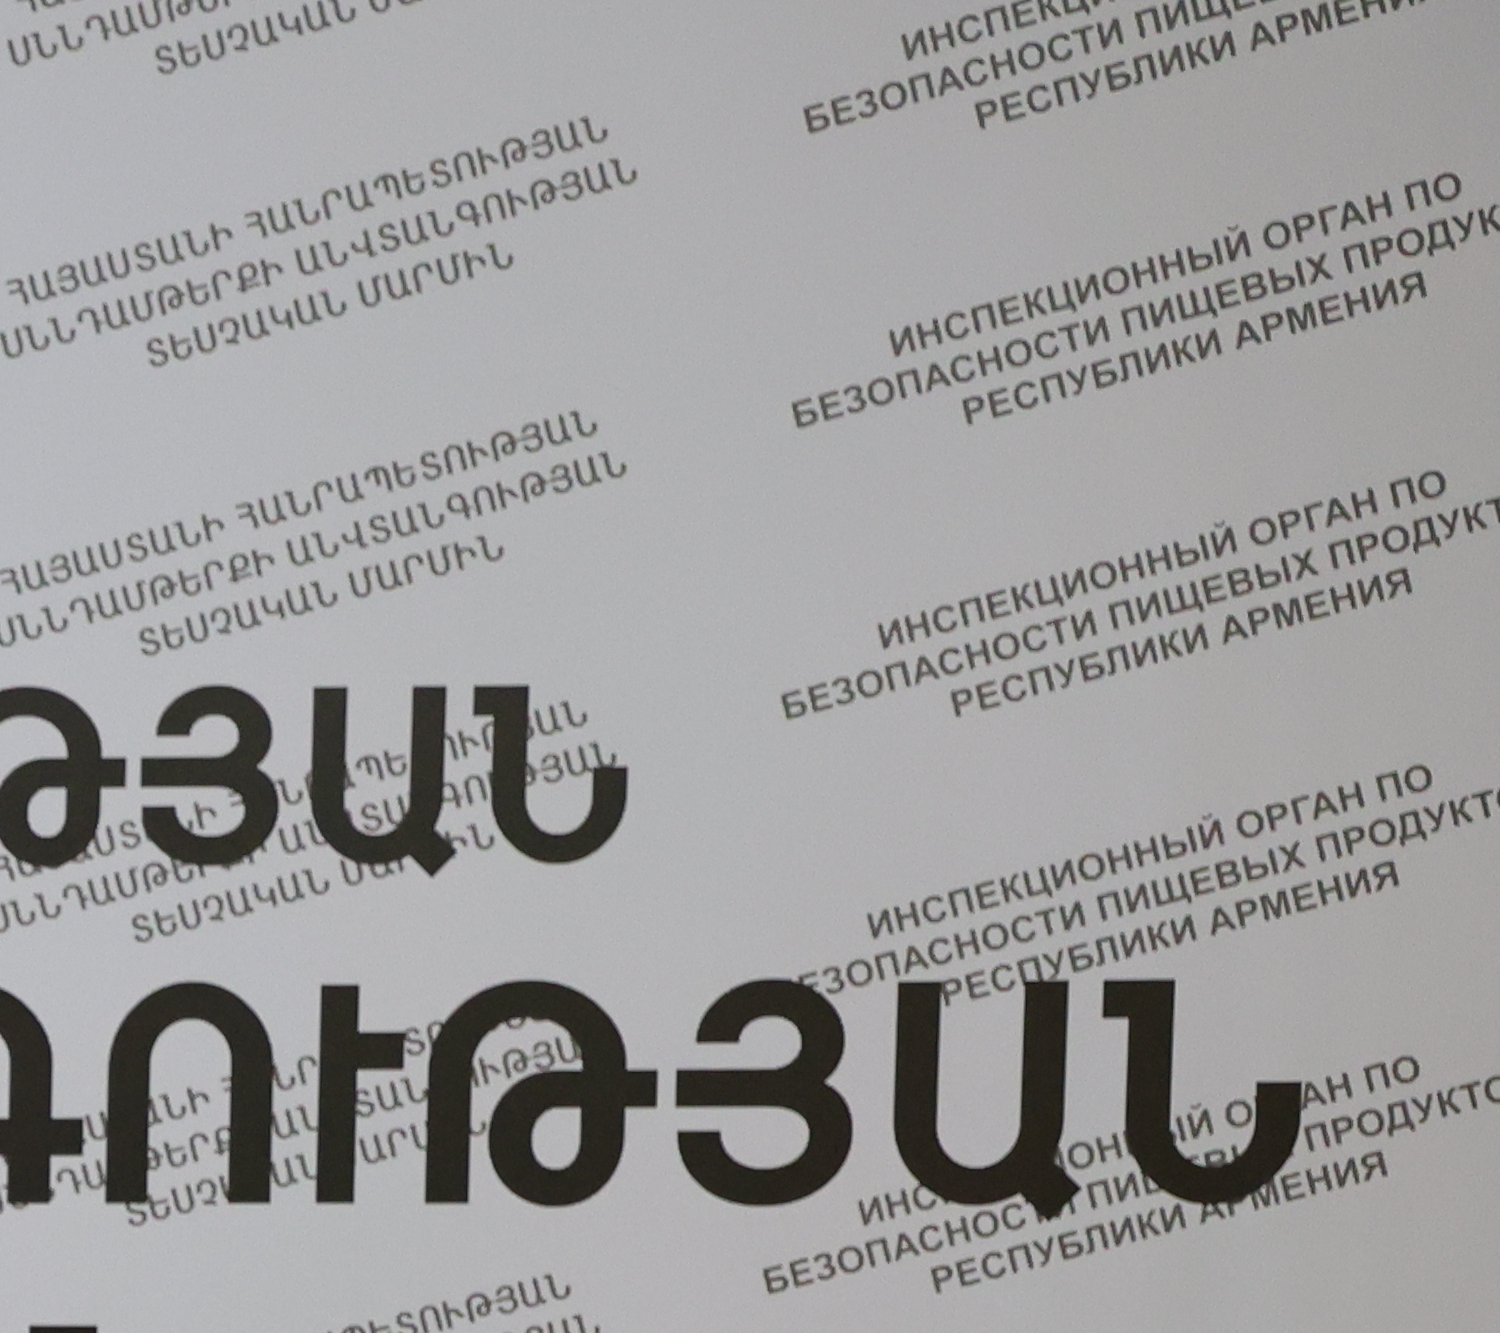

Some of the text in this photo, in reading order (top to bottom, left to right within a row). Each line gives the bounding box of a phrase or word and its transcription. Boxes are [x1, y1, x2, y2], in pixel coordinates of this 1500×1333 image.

[792, 316, 1110, 428] БЕЗОПАСНОСТИ
[1121, 253, 1333, 336] ПИЩЕВЫХ
[889, 173, 1461, 357] ИНСПЕКЦИОННЫЙ ОРГАН ПО
[962, 271, 1427, 425] РЕСПУБЛИКИ АРМЕНИЯ
[781, 610, 1097, 720] БЕЗОПАСНОСТИ
[1108, 548, 1318, 630] ПИЩЕВЫХ
[878, 471, 1446, 650] ИНСПЕКЦИОННЫЙ ОРГАН ПО
[951, 567, 1412, 717] РЕСПУБЛИКИ АРМЕНИЯ
